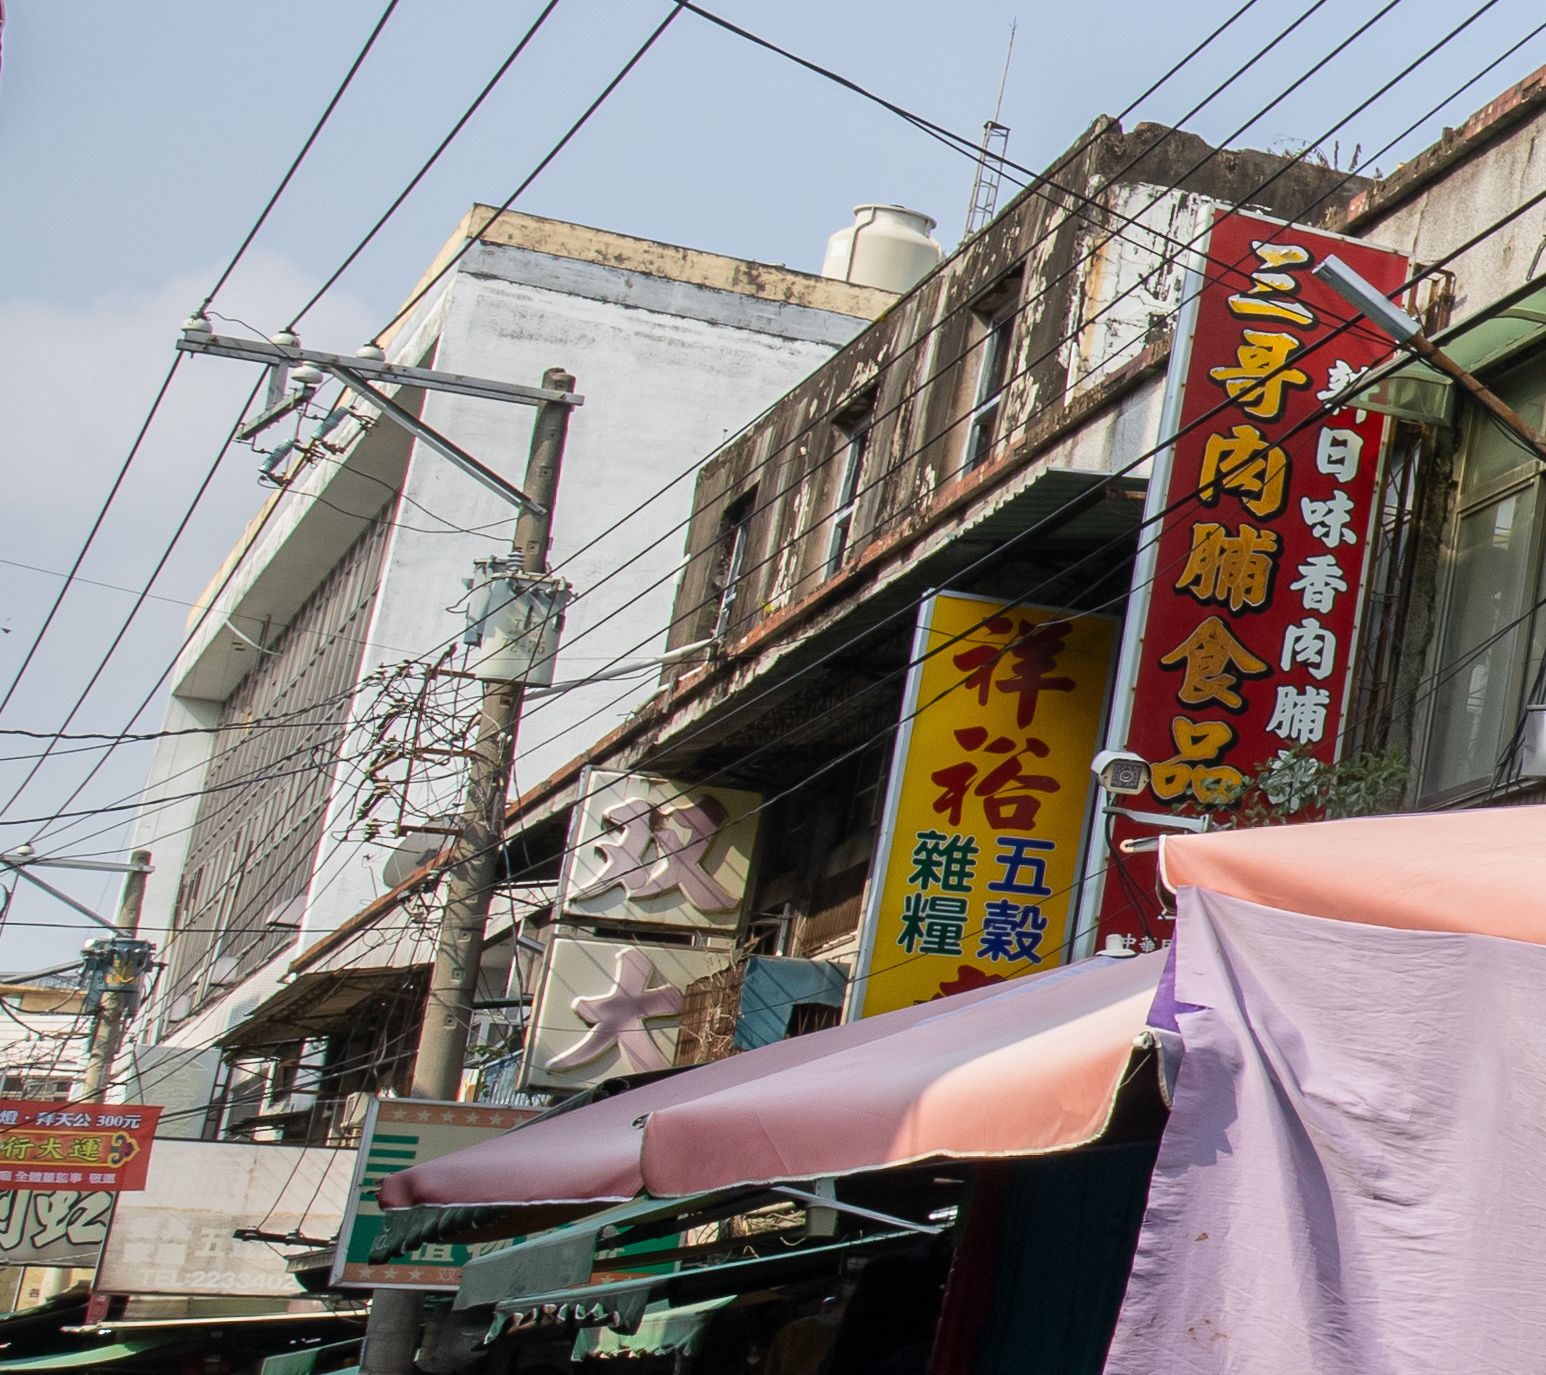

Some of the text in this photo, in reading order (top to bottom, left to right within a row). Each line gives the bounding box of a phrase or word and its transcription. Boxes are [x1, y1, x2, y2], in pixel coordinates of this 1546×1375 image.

[1150, 238, 1318, 806] 三哥肉脯食品
[930, 616, 1077, 832] 祥裕
[897, 829, 980, 958] 雜糧
[976, 834, 1057, 967] 五穀
[3, 1136, 102, 1163] 行大運
[96, 1113, 142, 1129] 300元
